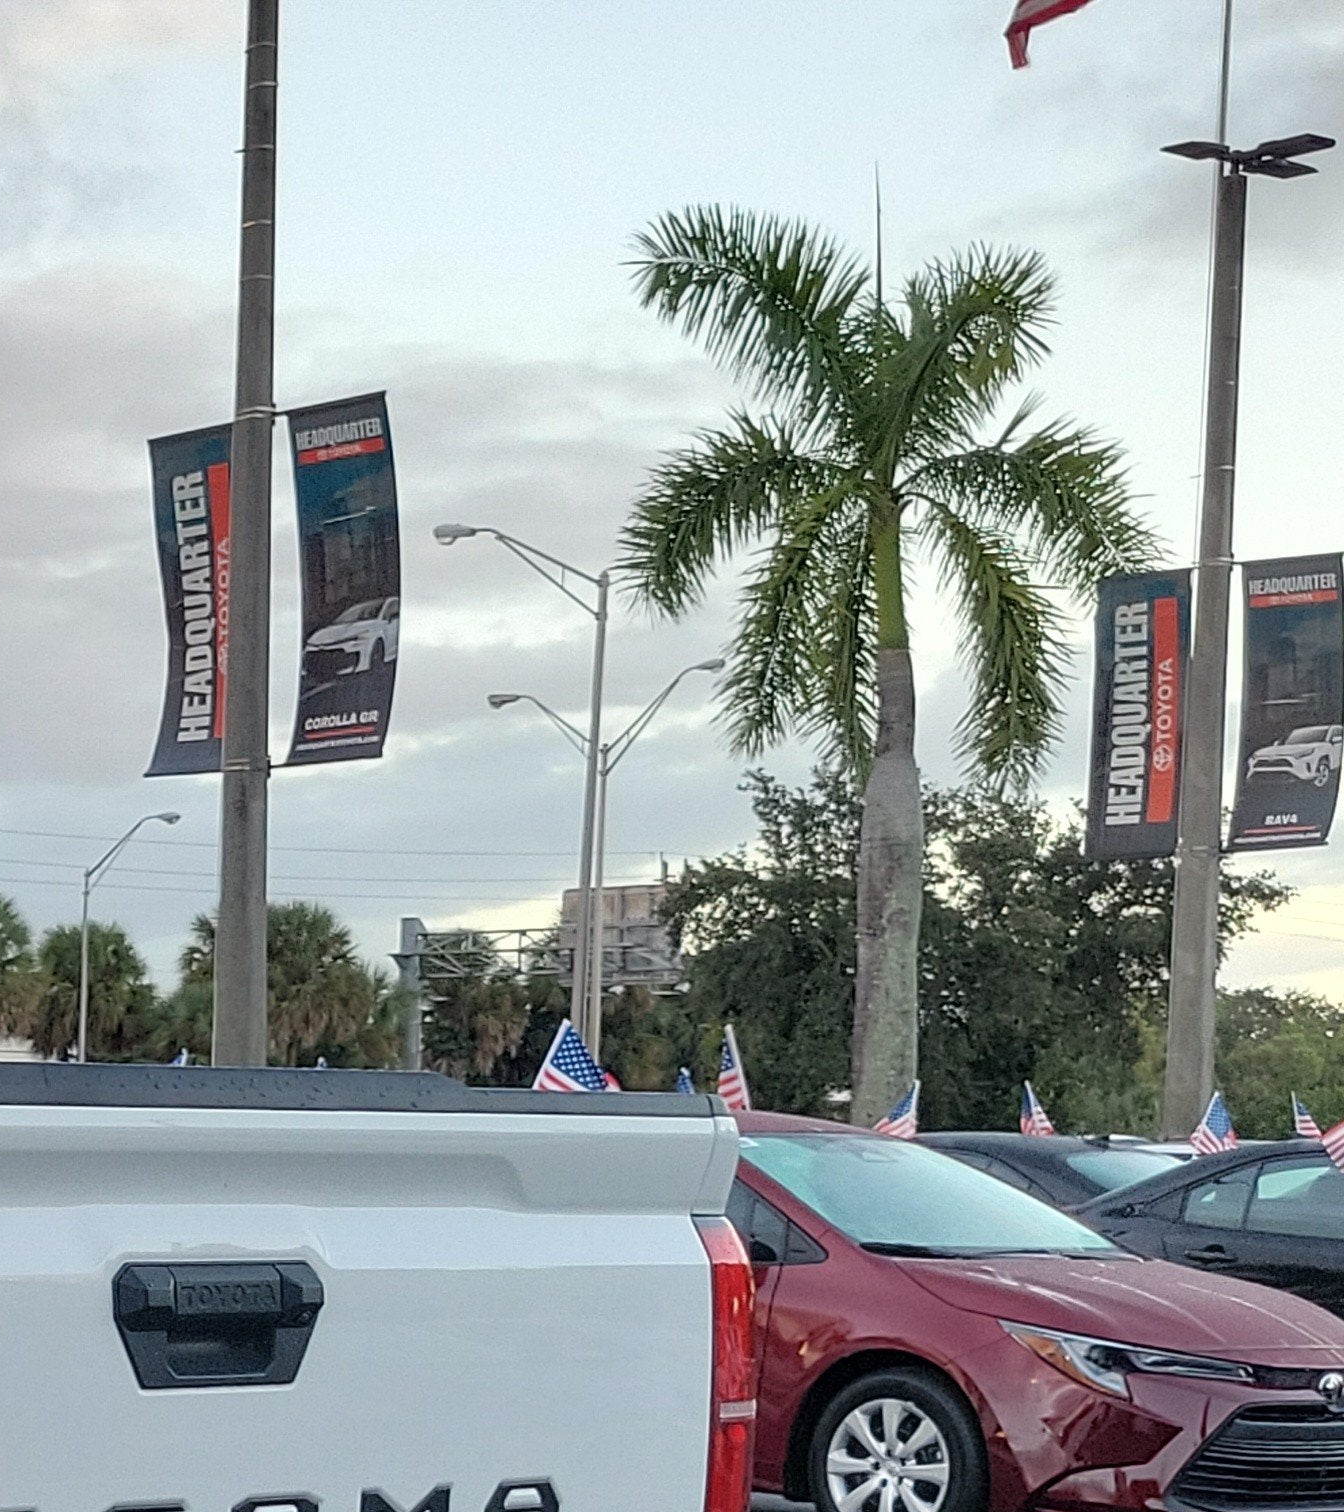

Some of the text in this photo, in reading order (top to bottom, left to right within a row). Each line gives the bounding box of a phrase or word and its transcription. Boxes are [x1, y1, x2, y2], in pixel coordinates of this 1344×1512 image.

[296, 417, 382, 451] HEADQUARTER
[1248, 573, 1337, 595] HEADQUARTER
[172, 470, 216, 742] HEADQUARTER
[1105, 602, 1151, 826] HEADQUARTER
[1156, 657, 1174, 742] TOYOTA
[305, 712, 358, 730] COROLLA
[180, 1283, 277, 1310] TOYOTA
